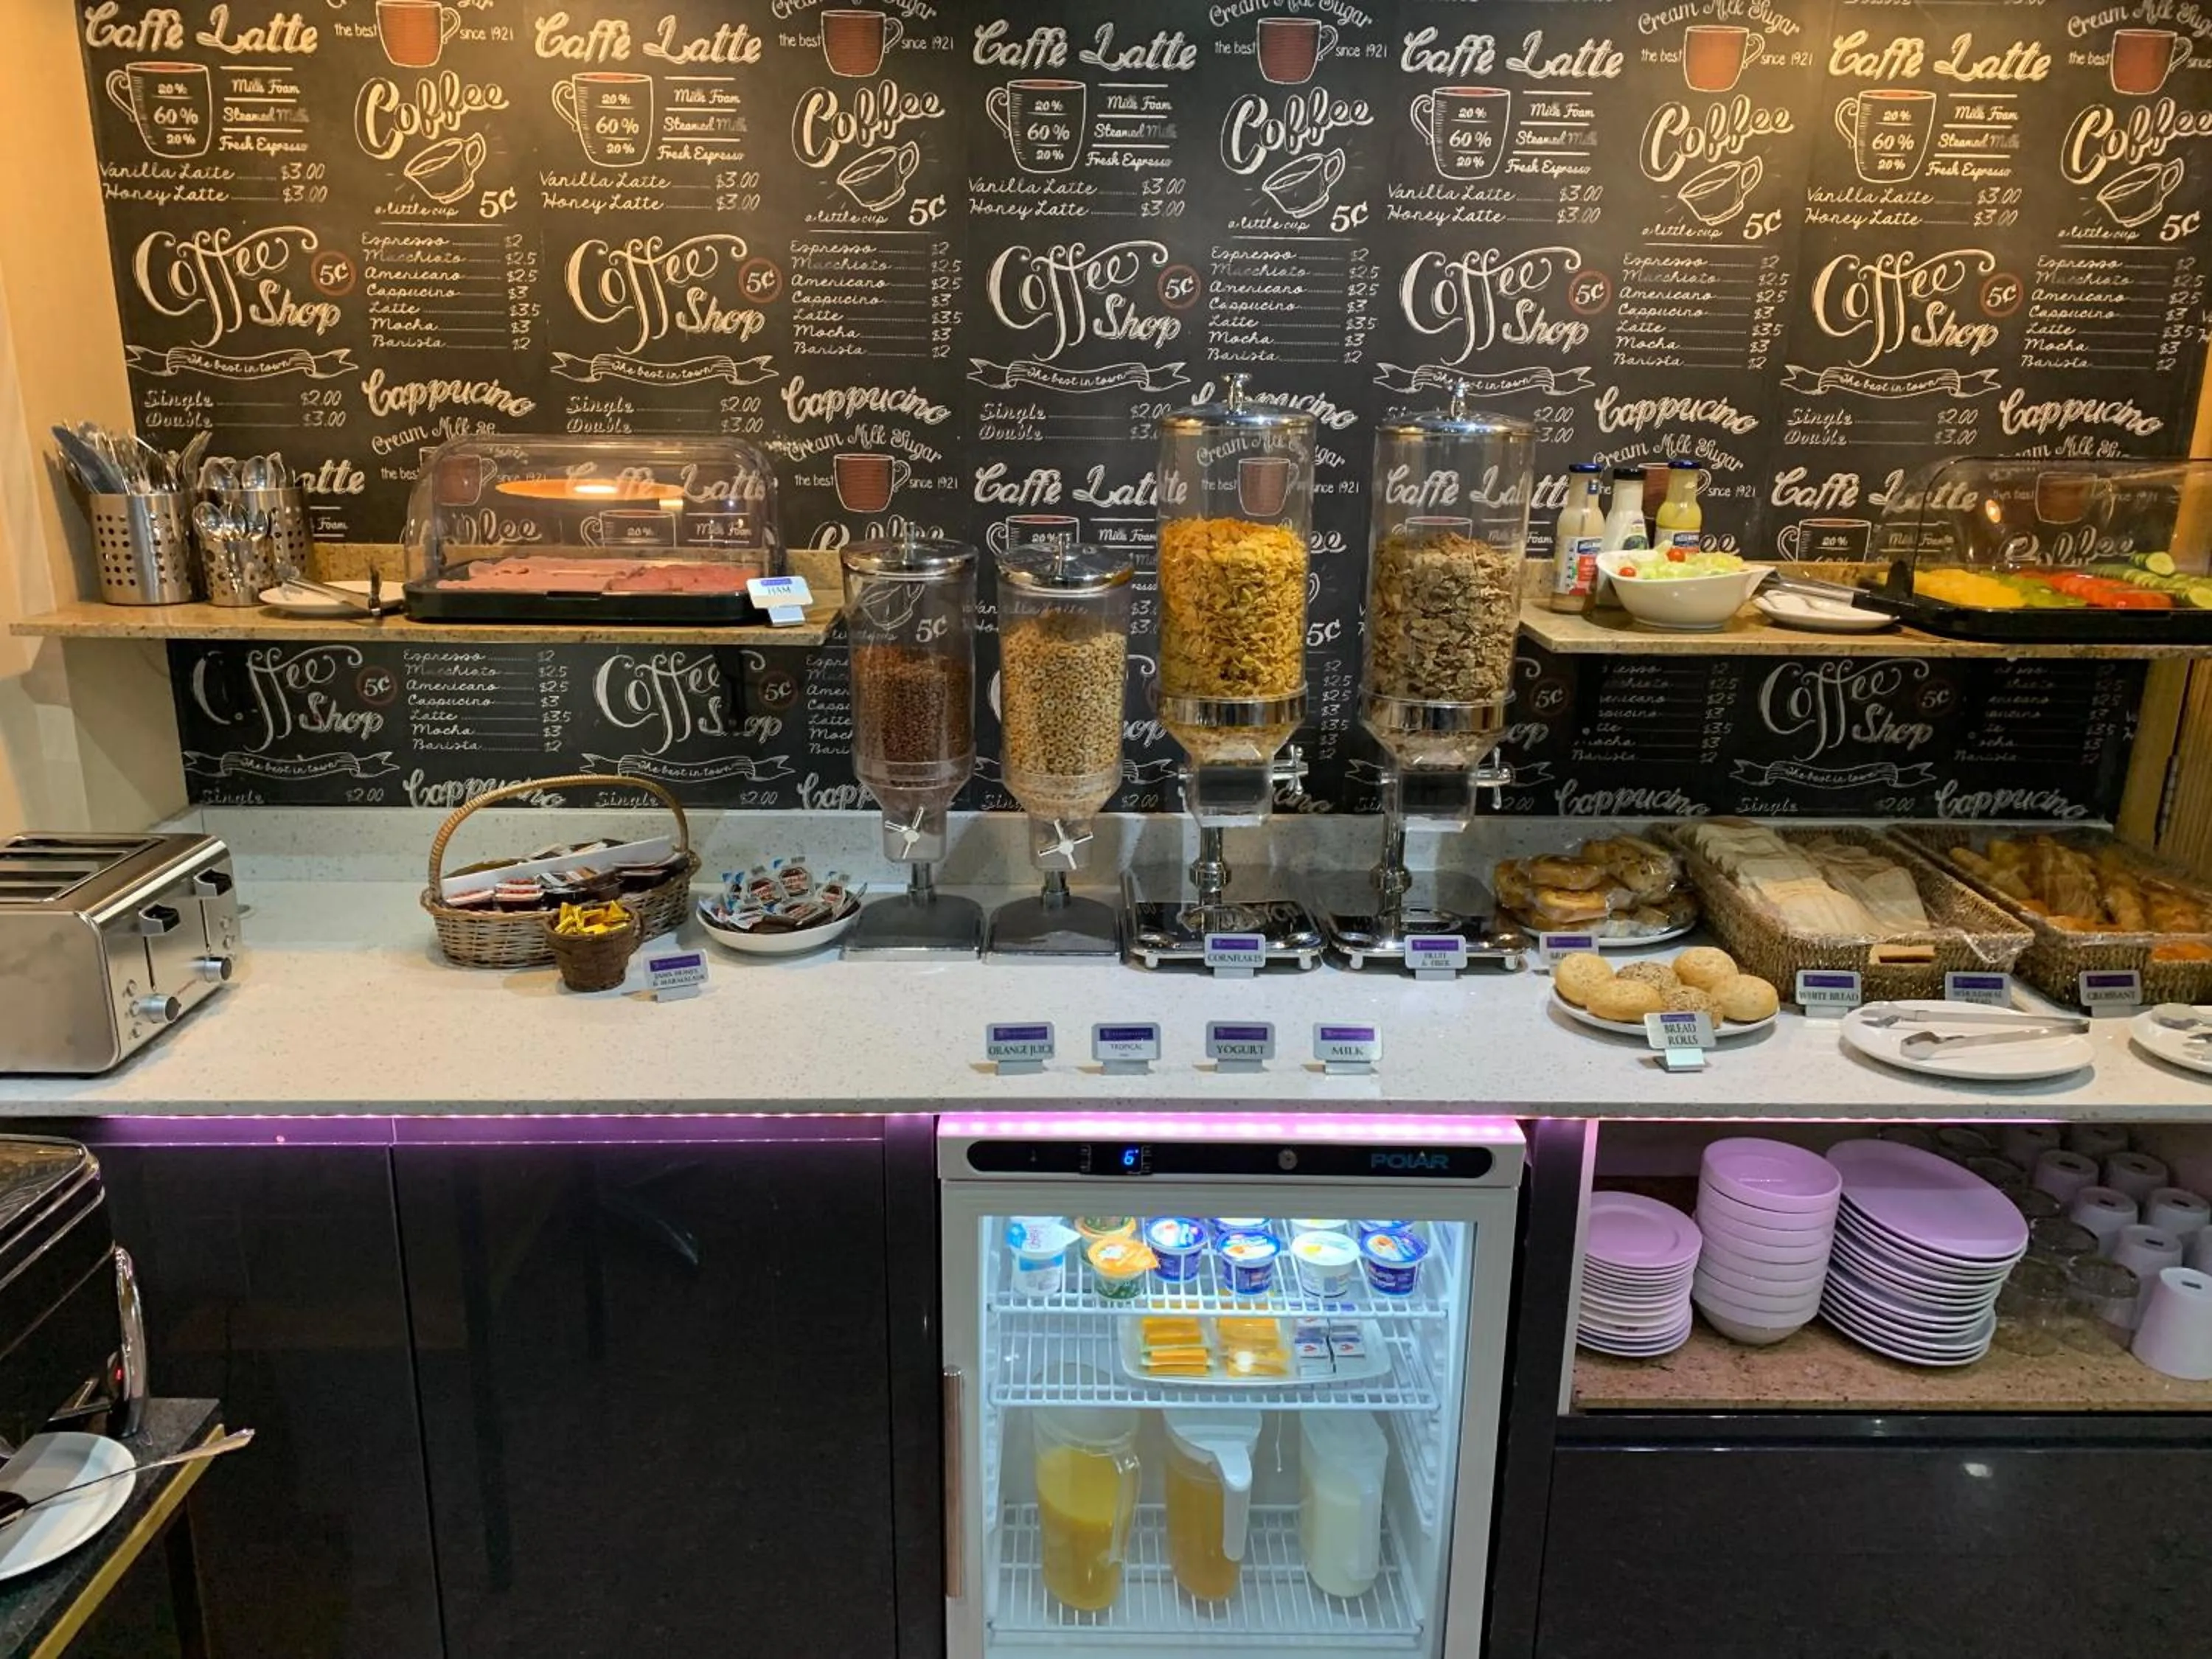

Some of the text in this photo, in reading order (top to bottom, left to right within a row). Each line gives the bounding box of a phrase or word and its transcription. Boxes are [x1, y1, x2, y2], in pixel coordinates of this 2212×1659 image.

[197, 4, 318, 55] Latte
[642, 14, 762, 65] Latte
[1638, 5, 1699, 35] Cream
[1079, 22, 1198, 72] Latte
[1366, 44, 1388, 58] 1921
[1506, 30, 1625, 80] Latte
[1933, 32, 2053, 82] Latte
[355, 70, 509, 159] Coffee
[791, 80, 945, 168] Coffee
[1220, 86, 1374, 175] Coffee
[1640, 94, 1795, 182] Coffee
[2060, 97, 2212, 184] Coffee
[100, 163, 175, 179] Vanilla
[178, 163, 234, 179] Latte
[102, 183, 229, 205] Honey Latte
[540, 171, 613, 188] Vanilla
[615, 172, 671, 188] Latte
[968, 178, 1040, 195] Vanilla
[1040, 178, 1098, 195] Latte
[1388, 184, 1459, 201] Vanilla
[1461, 185, 1517, 201] Latte
[542, 192, 664, 215] Honey Latte
[969, 199, 1033, 220] Honey
[1034, 200, 1089, 218] Latte
[1387, 205, 1506, 226] Honey Latte
[1804, 208, 1922, 229] Honey Latte
[1807, 187, 1878, 204] Vanilla
[1879, 187, 1934, 204] Latte
[133, 226, 319, 348] Coffee
[249, 279, 342, 335] Shop
[565, 234, 748, 355] Coffee
[987, 240, 1168, 361] Coffee
[1400, 246, 1582, 366] Coffee
[1812, 248, 1996, 368] Coffee
[676, 287, 765, 341] Shop
[794, 324, 861, 339] Mocha
[1093, 293, 1180, 349] Shop
[1502, 298, 1589, 353] Shop
[1911, 301, 1999, 356] Shop
[1208, 332, 1274, 345] Mocha
[1615, 338, 1680, 351] Mocha
[361, 368, 536, 417] Cappucino
[781, 375, 951, 425] Cappucino
[1595, 386, 1761, 434] Cappucino
[1999, 388, 2163, 437] Cappucino
[299, 691, 384, 742] Shop
[1759, 658, 1929, 762] Coffee
[1852, 703, 1933, 751] Shop
[1935, 779, 2088, 821] Cappucino
[1208, 953, 1263, 963] CORNFLAKES
[1798, 990, 1859, 1001] WHITE BREAD
[989, 1044, 1054, 1057] ORANGE JUICE
[1216, 1045, 1265, 1055] YOGURT
[1332, 1046, 1364, 1055] MILK
[1664, 1023, 1696, 1032] BREAD
[1668, 1035, 1698, 1045] ROLLS
